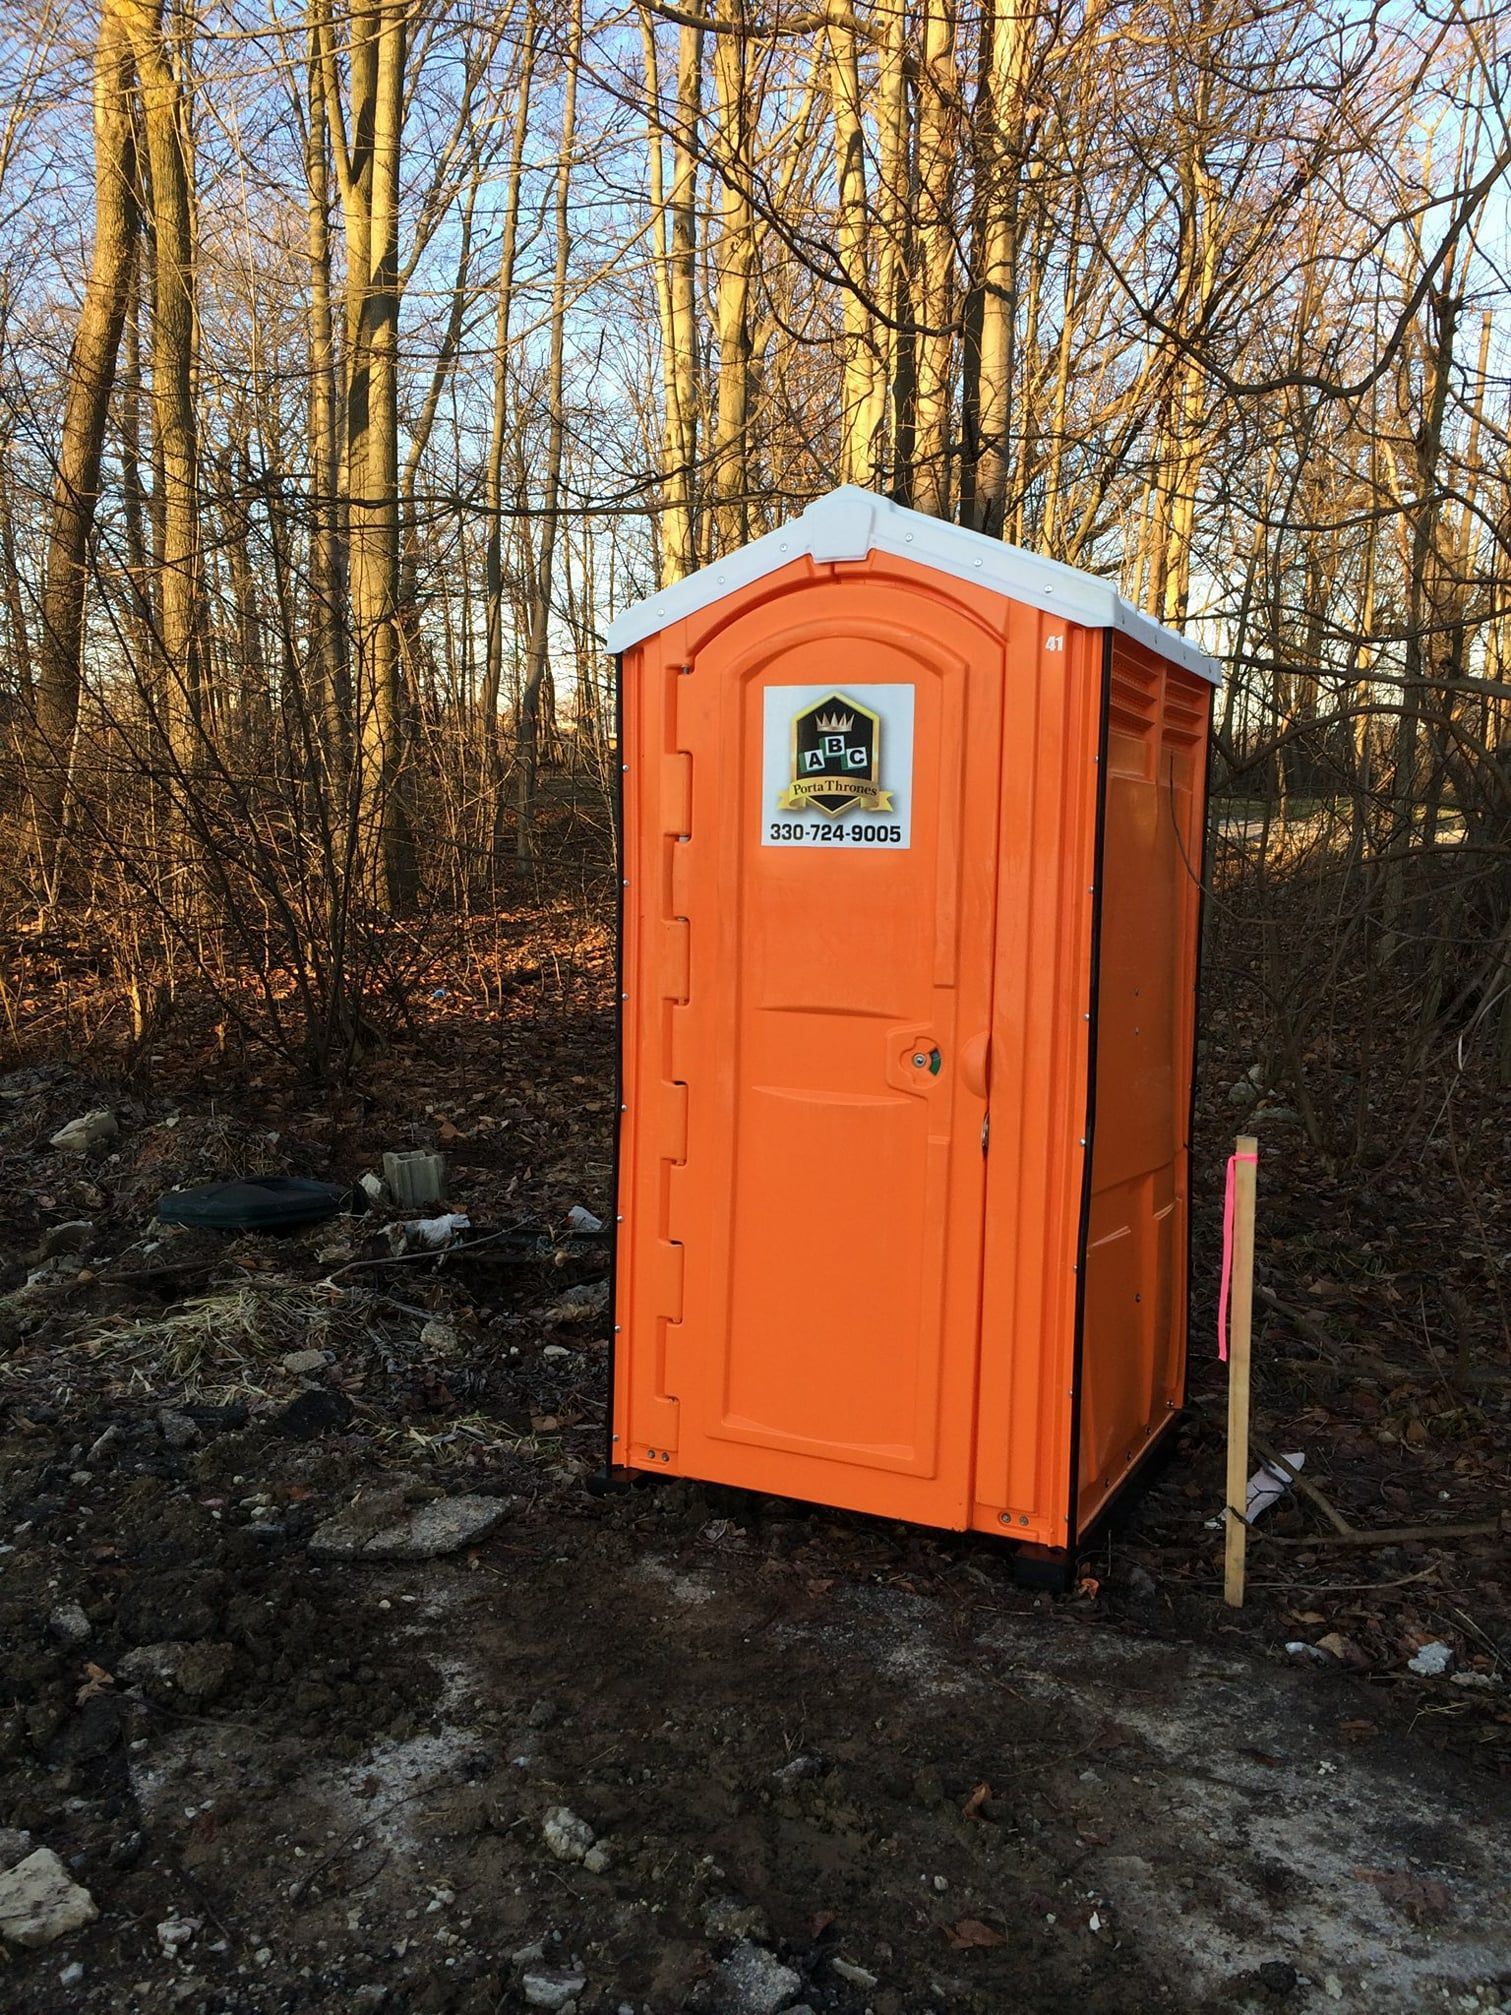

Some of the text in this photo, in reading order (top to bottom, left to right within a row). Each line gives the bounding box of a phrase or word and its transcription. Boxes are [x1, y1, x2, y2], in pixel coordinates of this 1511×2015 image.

[1045, 635, 1064, 652] 41
[793, 780, 878, 797] Porta Thrones
[770, 823, 902, 843] 330-724-9005
